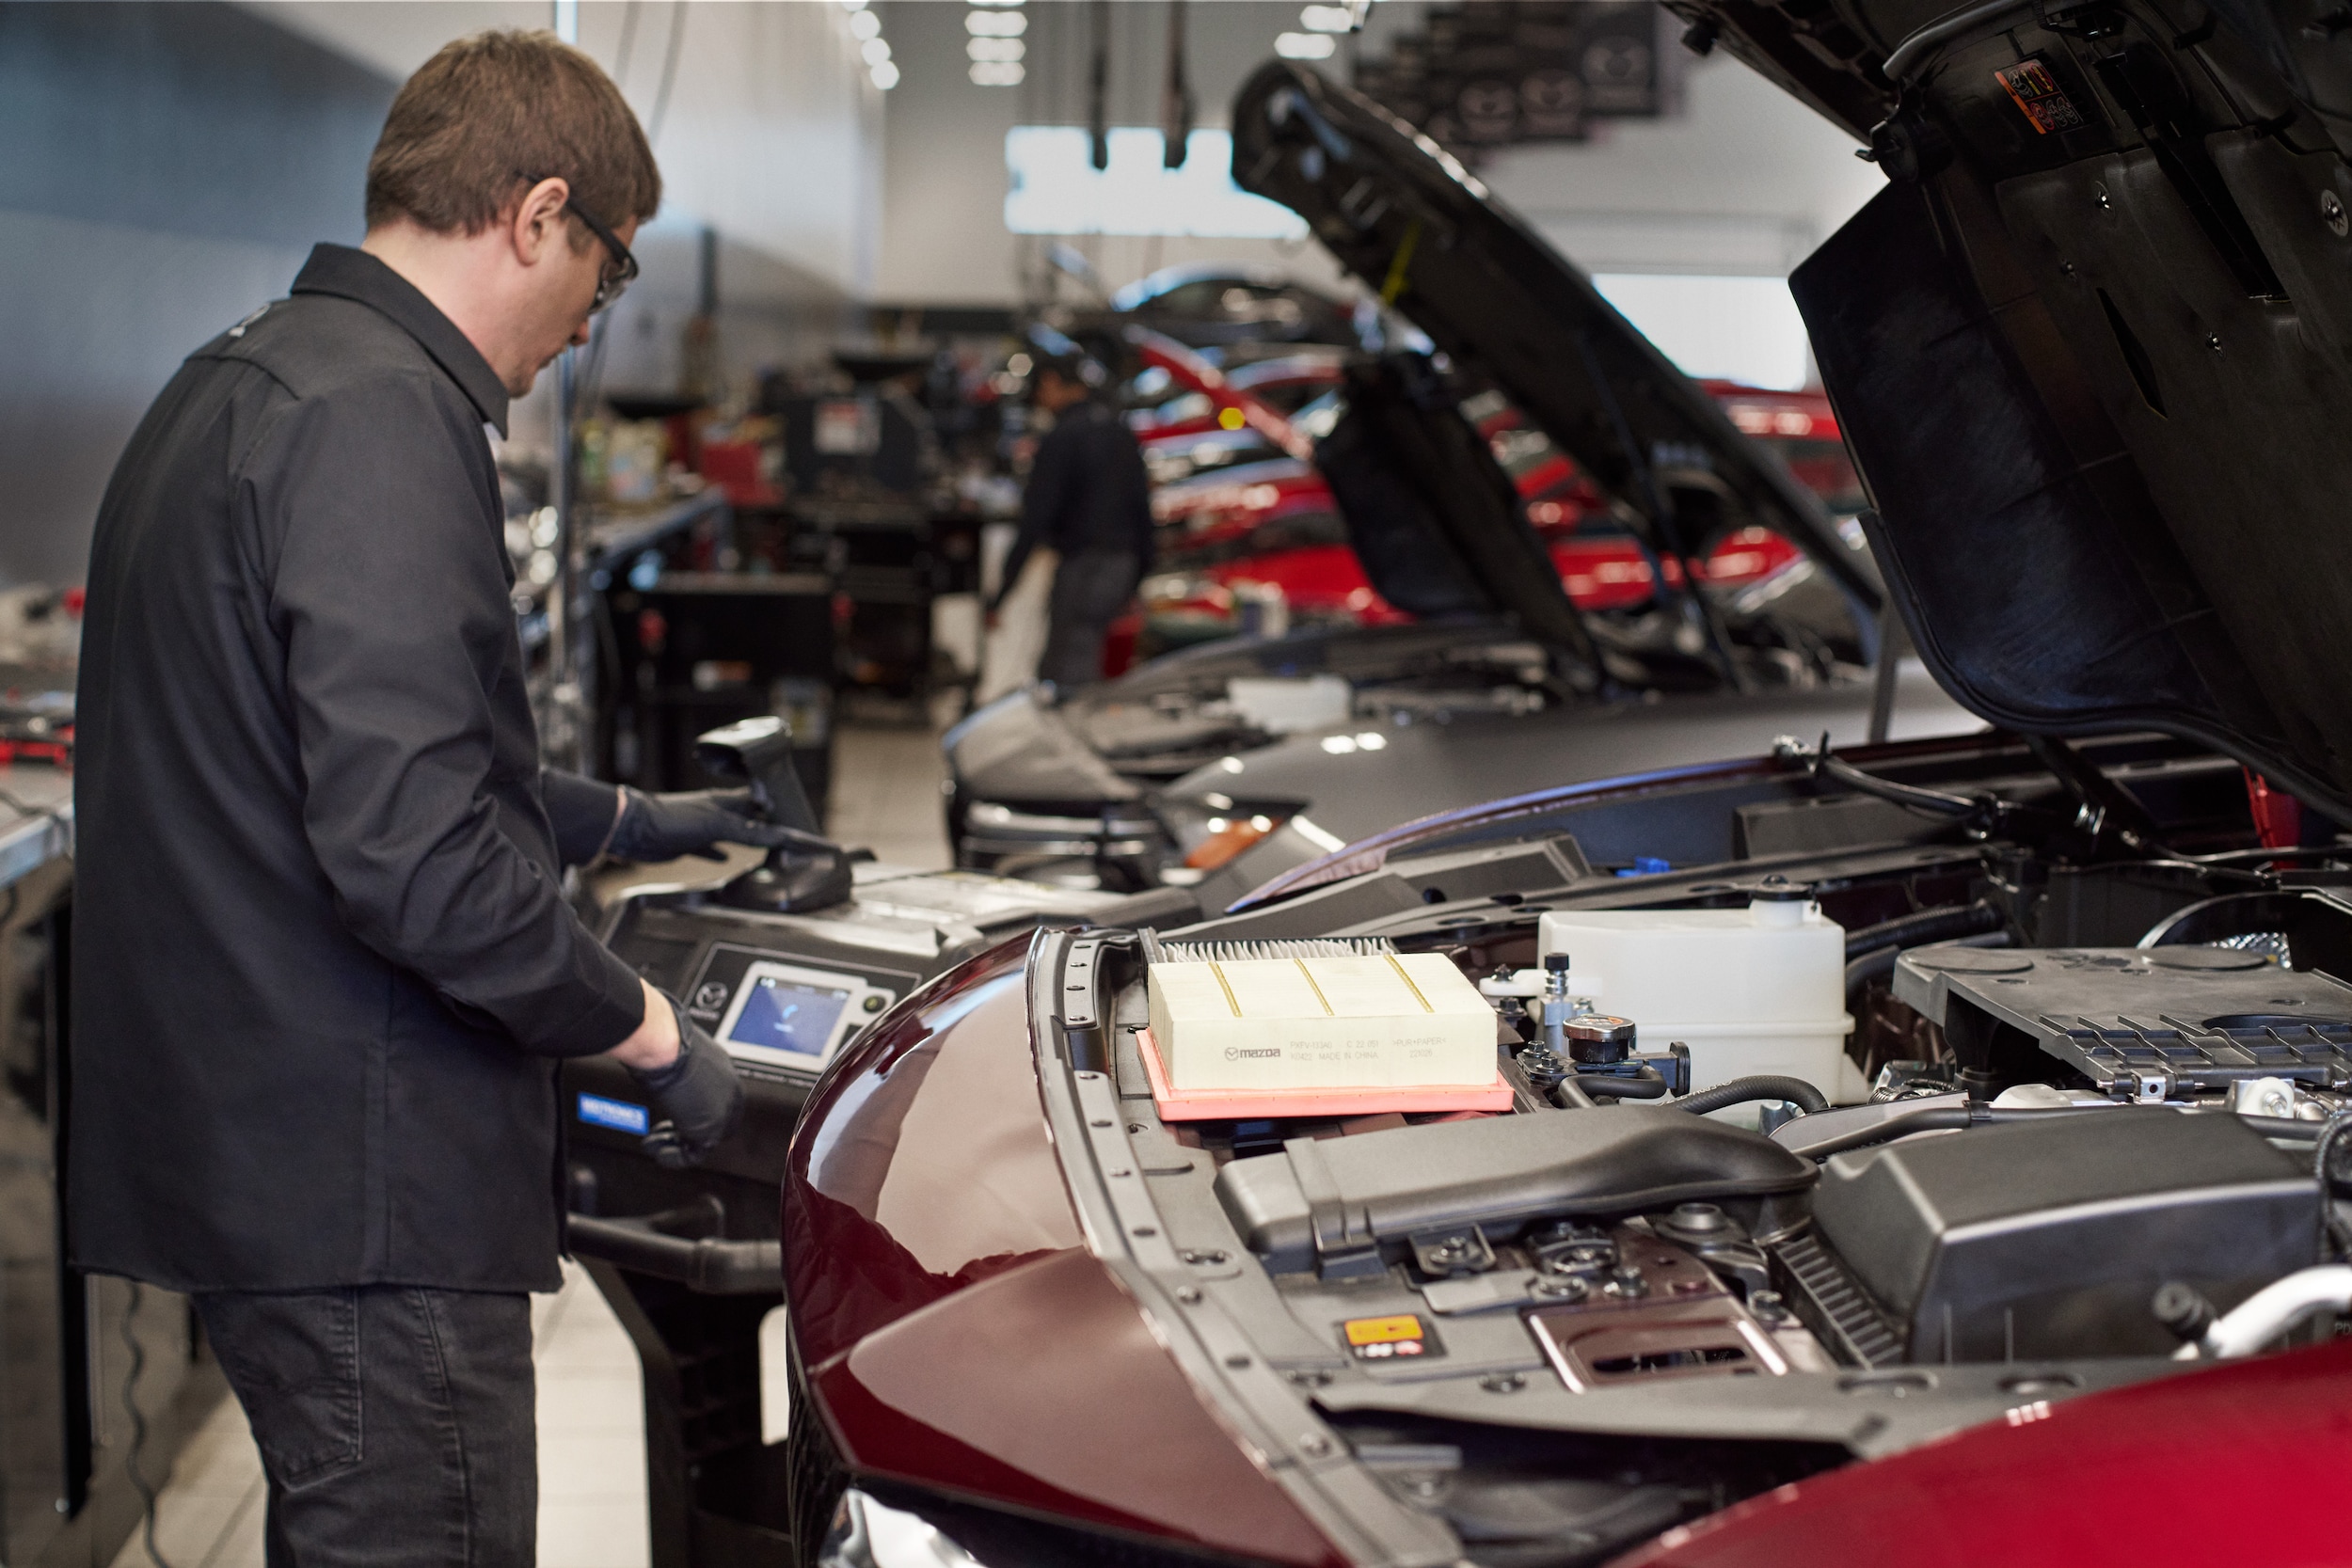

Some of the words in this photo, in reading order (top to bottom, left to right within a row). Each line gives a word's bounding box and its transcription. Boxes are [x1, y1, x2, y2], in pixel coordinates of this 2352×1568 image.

[1346, 1039, 1353, 1049] C
[1356, 1039, 1365, 1049] 22
[1240, 1049, 1280, 1058] mazda
[1318, 1051, 1341, 1061] MADE
[1343, 1051, 1352, 1060] IN
[1355, 1051, 1379, 1060] CHINA
